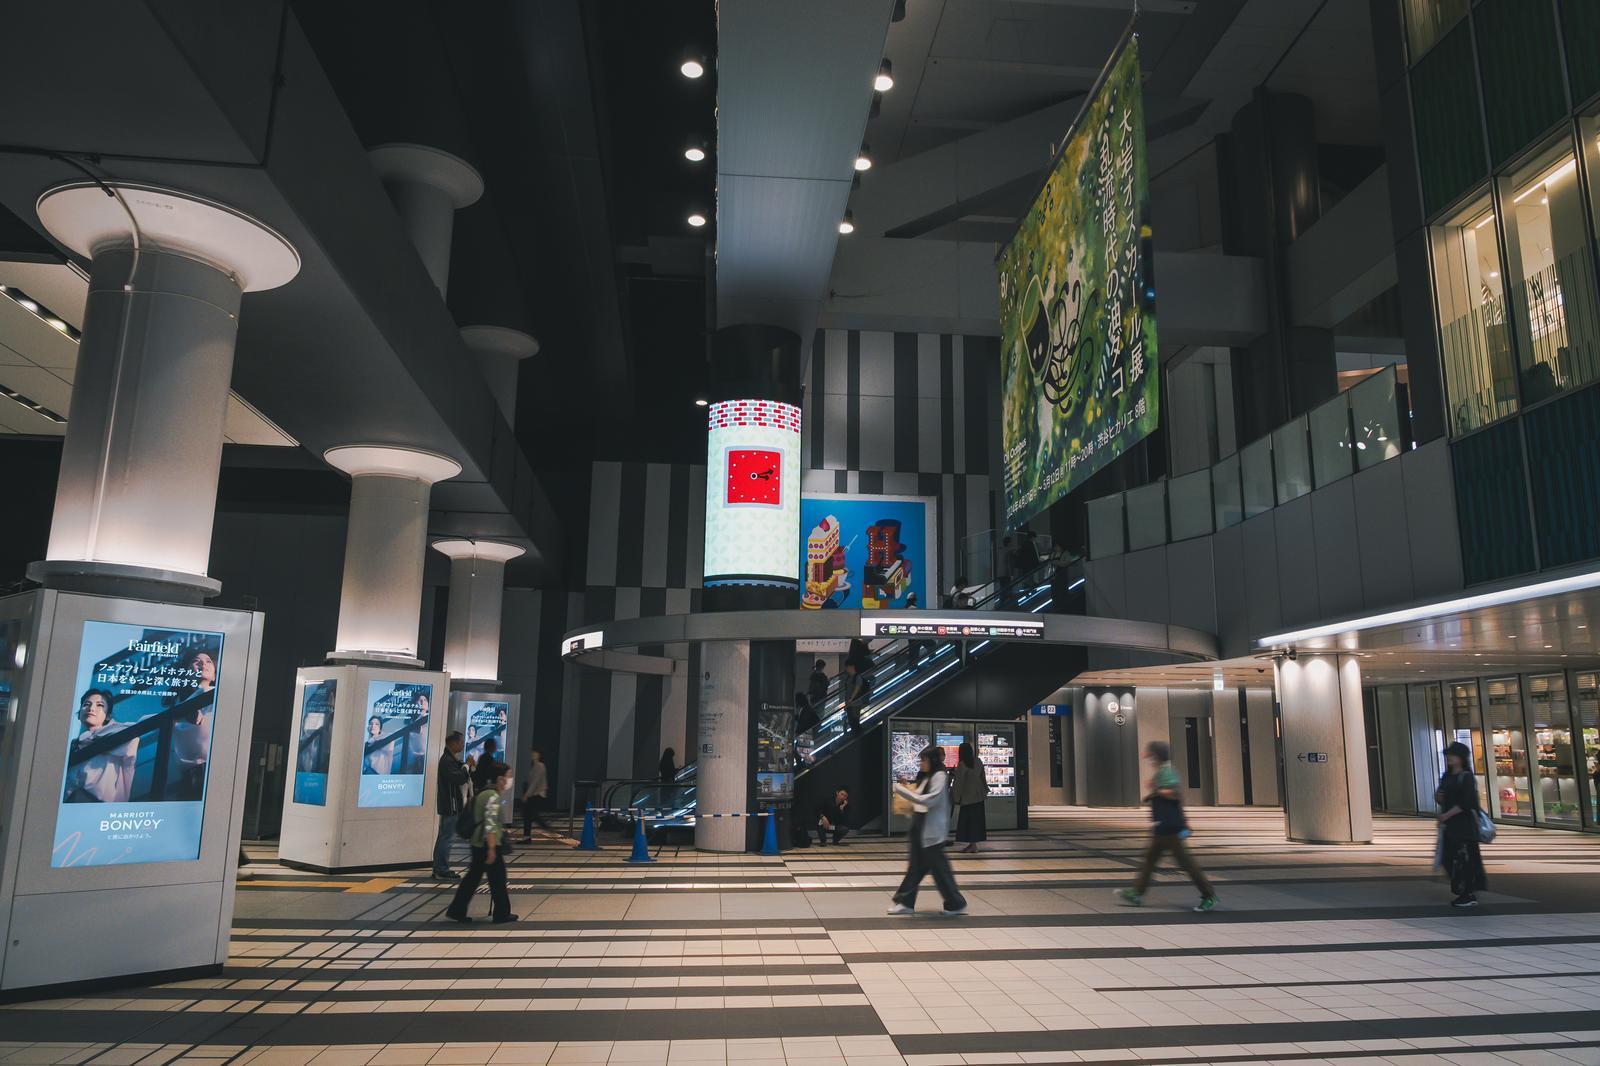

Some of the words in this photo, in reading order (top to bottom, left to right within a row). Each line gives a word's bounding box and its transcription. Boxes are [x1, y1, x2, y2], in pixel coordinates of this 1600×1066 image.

[1118, 108, 1144, 383] 大岩オスカール展
[128, 639, 181, 655] Fairfield
[97, 673, 202, 688] 日本をもっと深く旅する。
[109, 811, 155, 819] MARRIOTT
